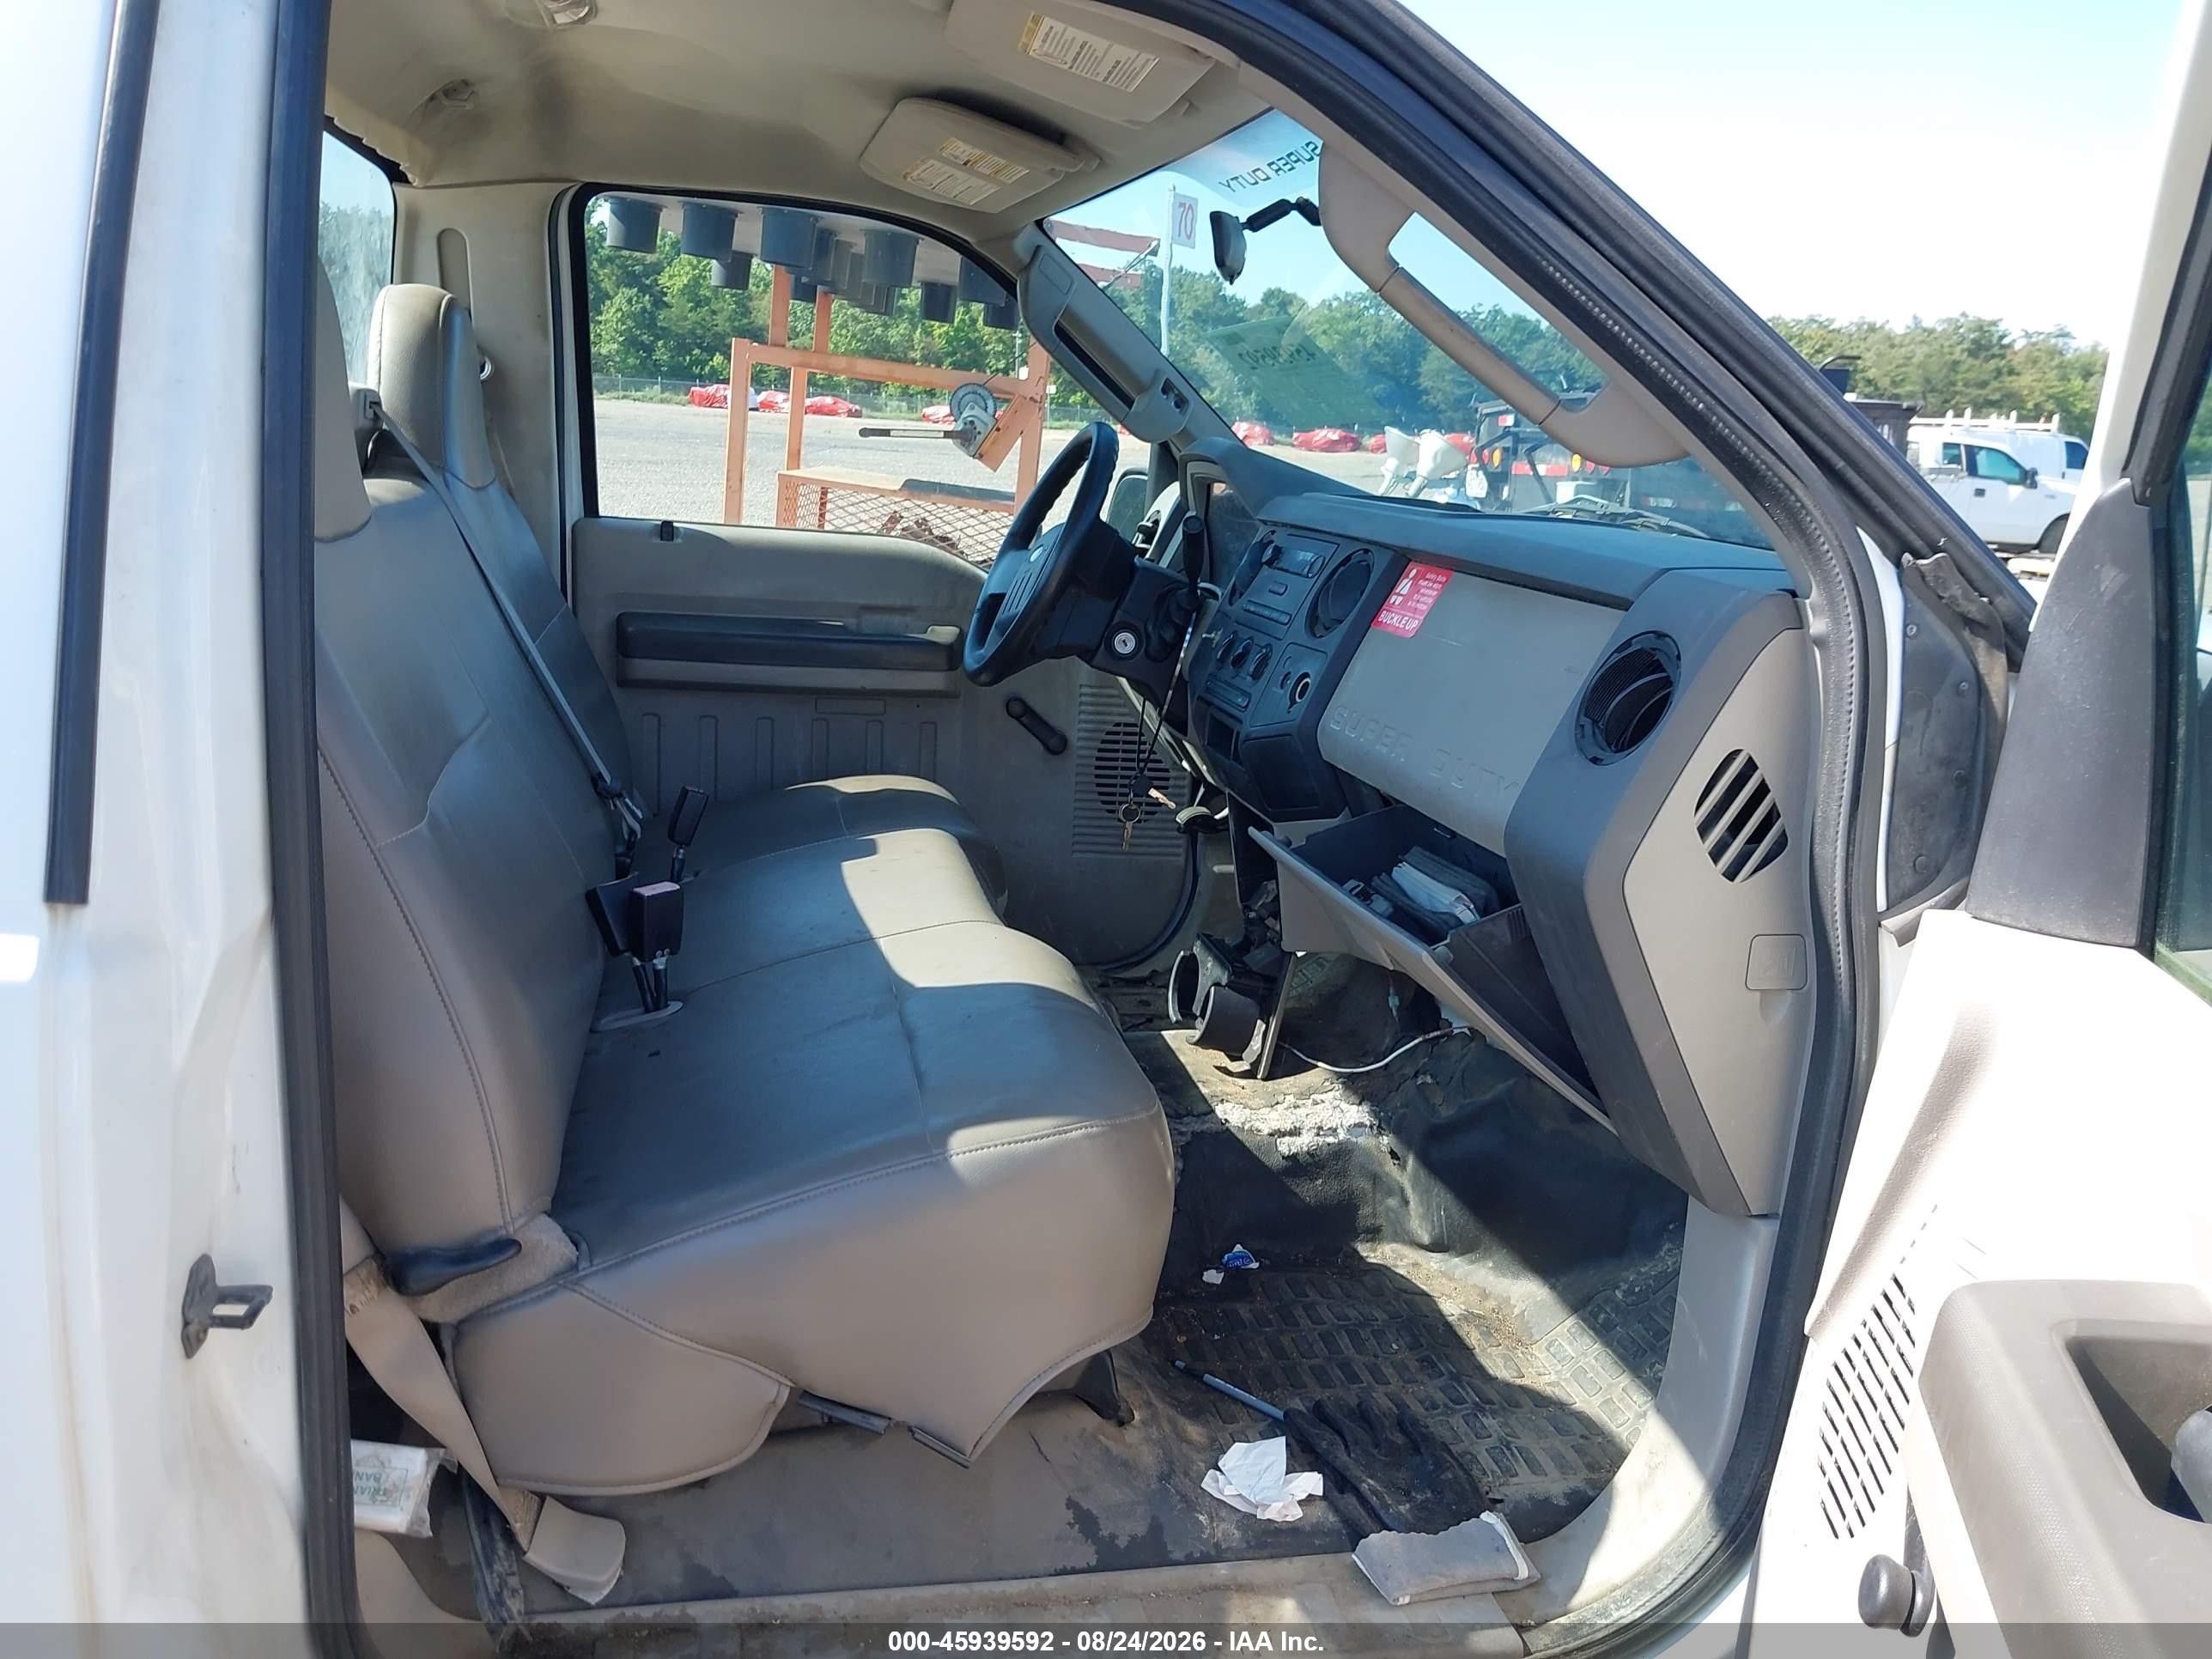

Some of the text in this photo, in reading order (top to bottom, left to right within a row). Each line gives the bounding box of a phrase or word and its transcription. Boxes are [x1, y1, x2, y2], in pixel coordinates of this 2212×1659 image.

[1178, 202, 1194, 240] 70
[1378, 611, 1419, 631] BUCKLE UP
[1330, 705, 1415, 763] SUPER
